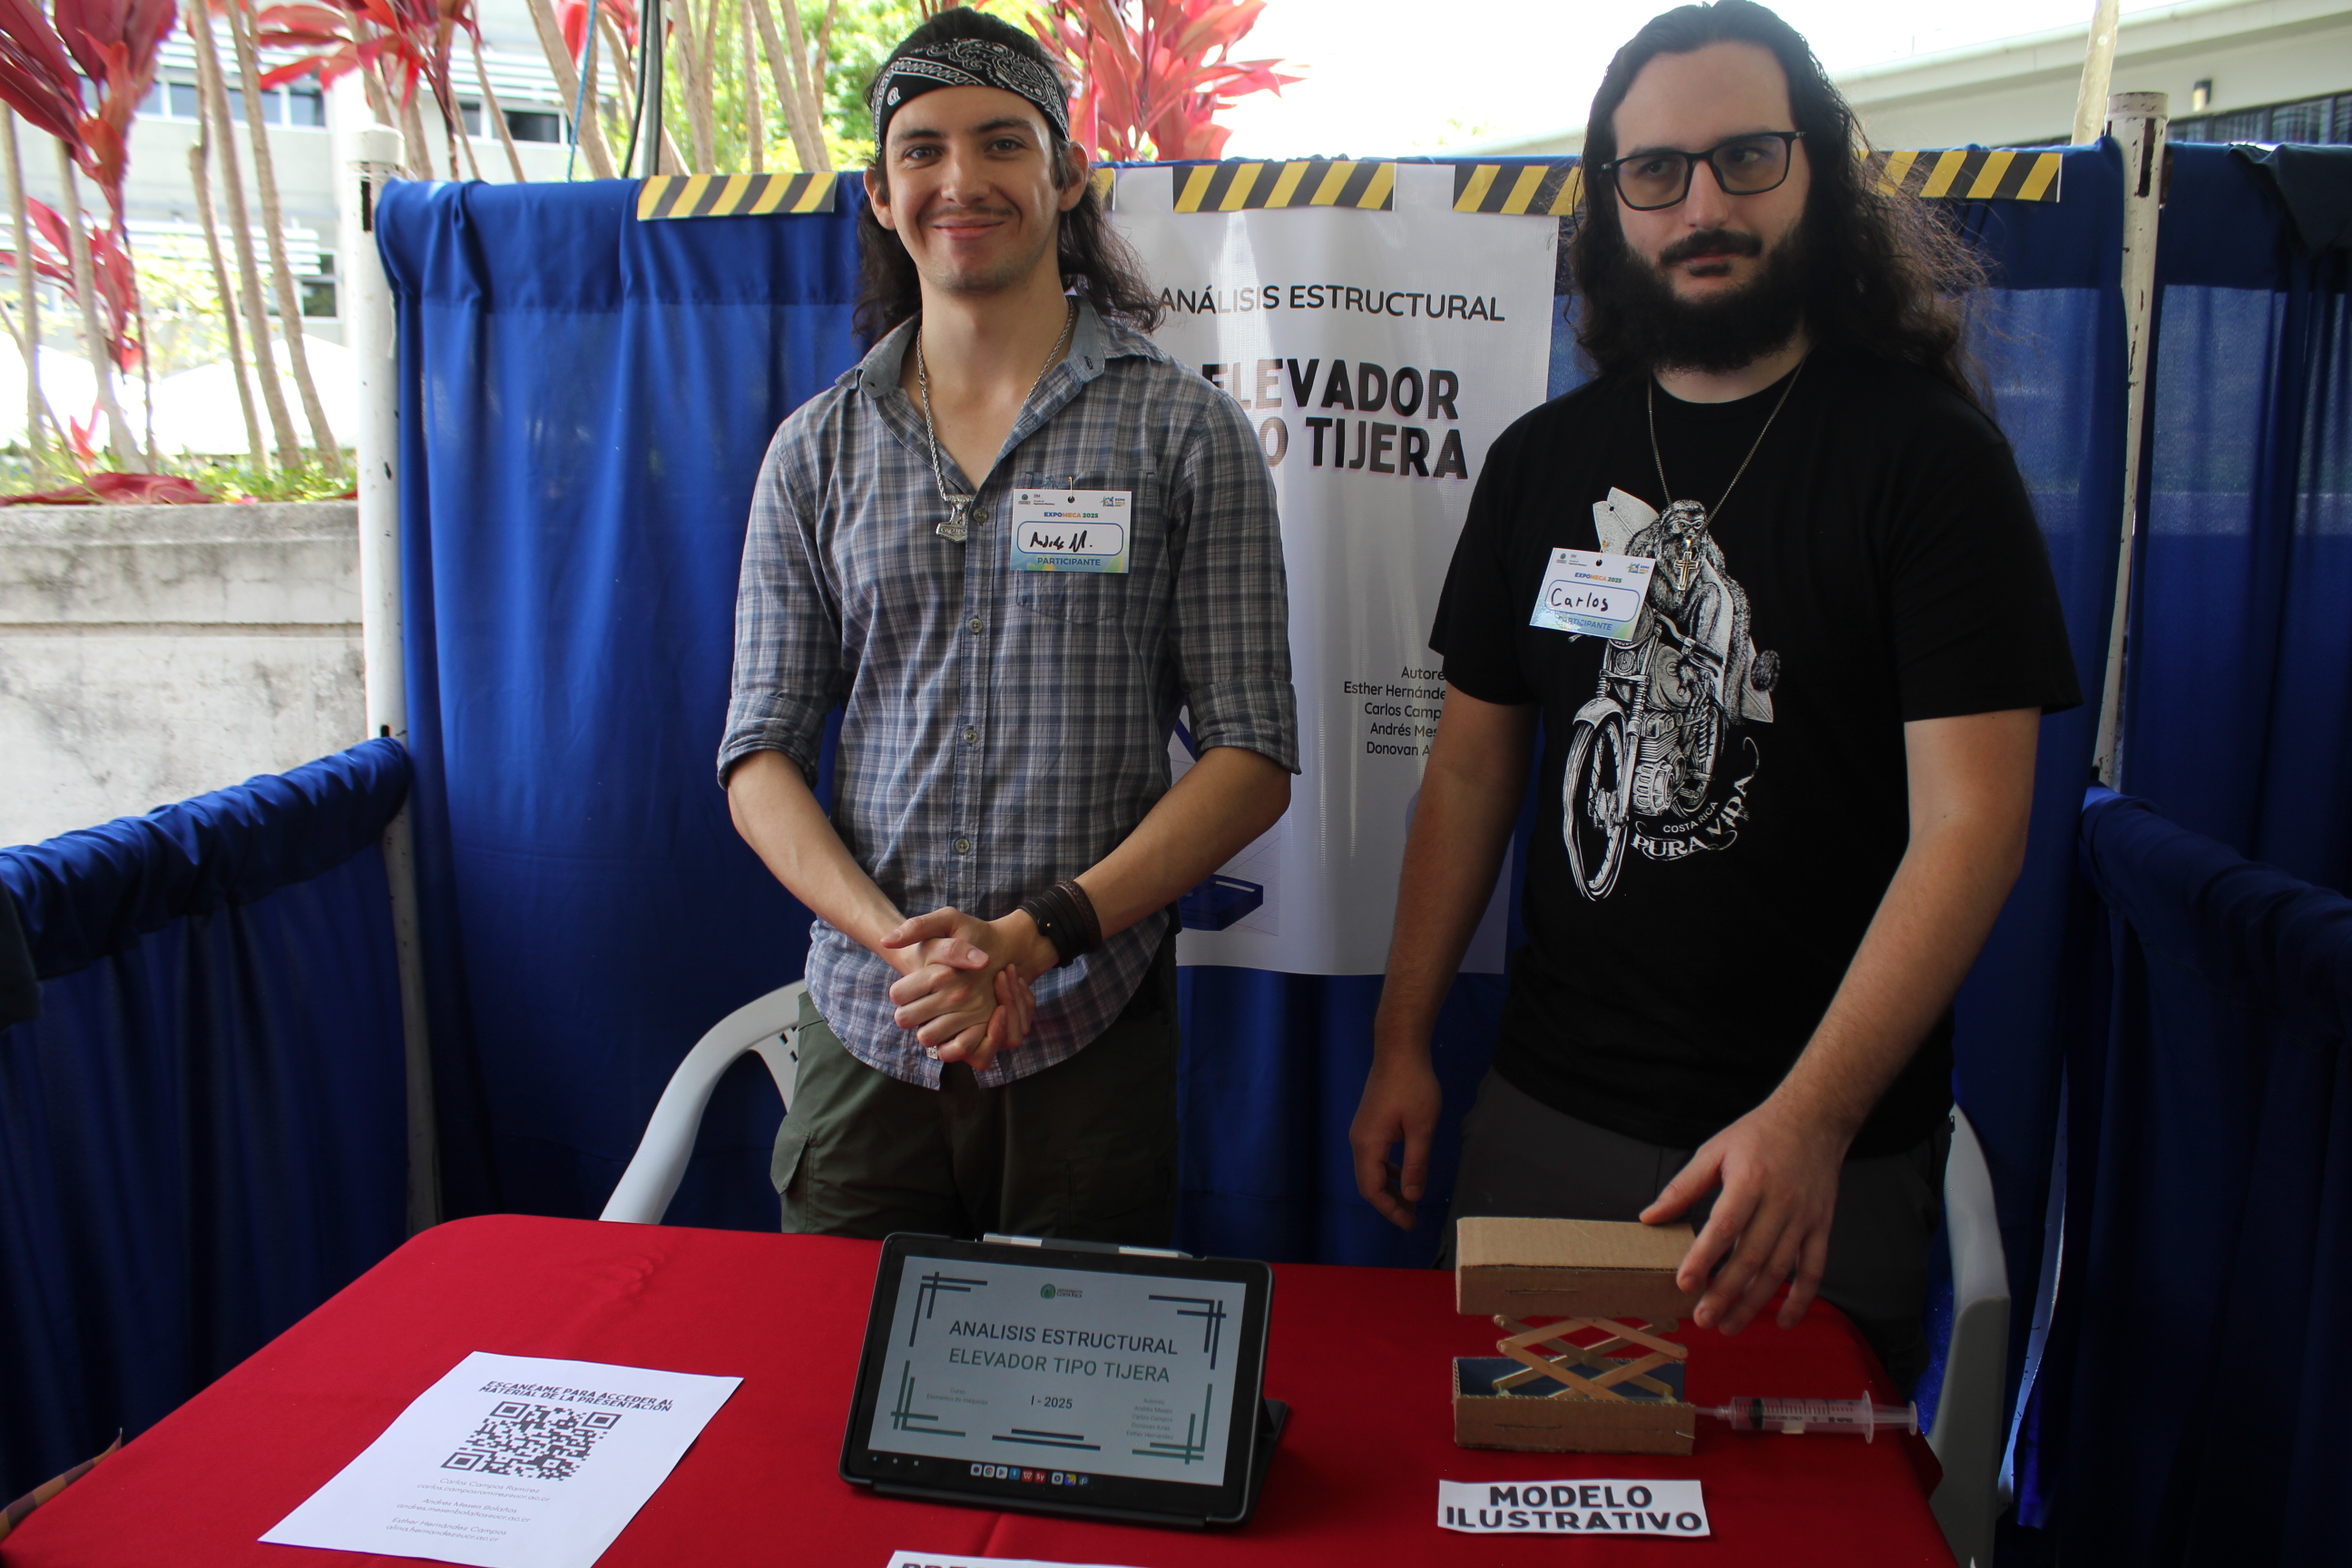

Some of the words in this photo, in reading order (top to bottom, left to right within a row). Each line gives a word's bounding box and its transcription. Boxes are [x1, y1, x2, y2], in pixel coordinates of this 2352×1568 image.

[1161, 284, 1280, 314] ANÁLISIS
[1289, 285, 1505, 321] ESTRUCTURAL
[1305, 416, 1468, 480] TIJERA
[1037, 557, 1101, 566] PARTICIPANTE
[1574, 573, 1607, 581] EXPOMECA
[1551, 588, 1609, 612] Carlos
[1558, 615, 1612, 631] PARTICIPANTE
[1401, 666, 1446, 681] Autore
[1344, 681, 1383, 696] Esther
[1386, 684, 1446, 700] Hernánde
[1365, 702, 1401, 716] Carlos
[1405, 705, 1442, 721] Camp
[1370, 722, 1411, 737] Andrés
[1415, 725, 1437, 738] Mes
[1367, 741, 1419, 756] Donovan
[1422, 744, 1431, 756] A
[1631, 833, 1708, 857] PURA
[1706, 774, 1754, 835] VIDA
[1662, 821, 1699, 833] COSTA
[1698, 801, 1719, 824] RICA
[949, 1320, 1036, 1343] ANALISIS
[1042, 1328, 1179, 1355] ESTRUCTURAL
[949, 1348, 1047, 1372] ELEVADOR
[1054, 1357, 1097, 1377] TIPO
[1104, 1362, 1171, 1383] TIJERA
[478, 1386, 537, 1397] MATERIAL
[539, 1392, 560, 1400] DE
[576, 1396, 672, 1412] PRESENTACIÓN
[485, 1380, 563, 1394] ESCANÉAME
[564, 1387, 596, 1398] PARA
[598, 1392, 658, 1405] ACCEDER
[1044, 1396, 1073, 1409] 2025
[439, 1477, 466, 1486] Carlos
[469, 1481, 504, 1490] Campos
[1490, 1485, 1652, 1507] MODELO
[422, 1498, 452, 1506] Andrés
[483, 1504, 517, 1514] Bolaños
[392, 1517, 419, 1525] Esther
[470, 1526, 507, 1536] Campos
[1446, 1506, 1702, 1531] ILUSTRATIVO
